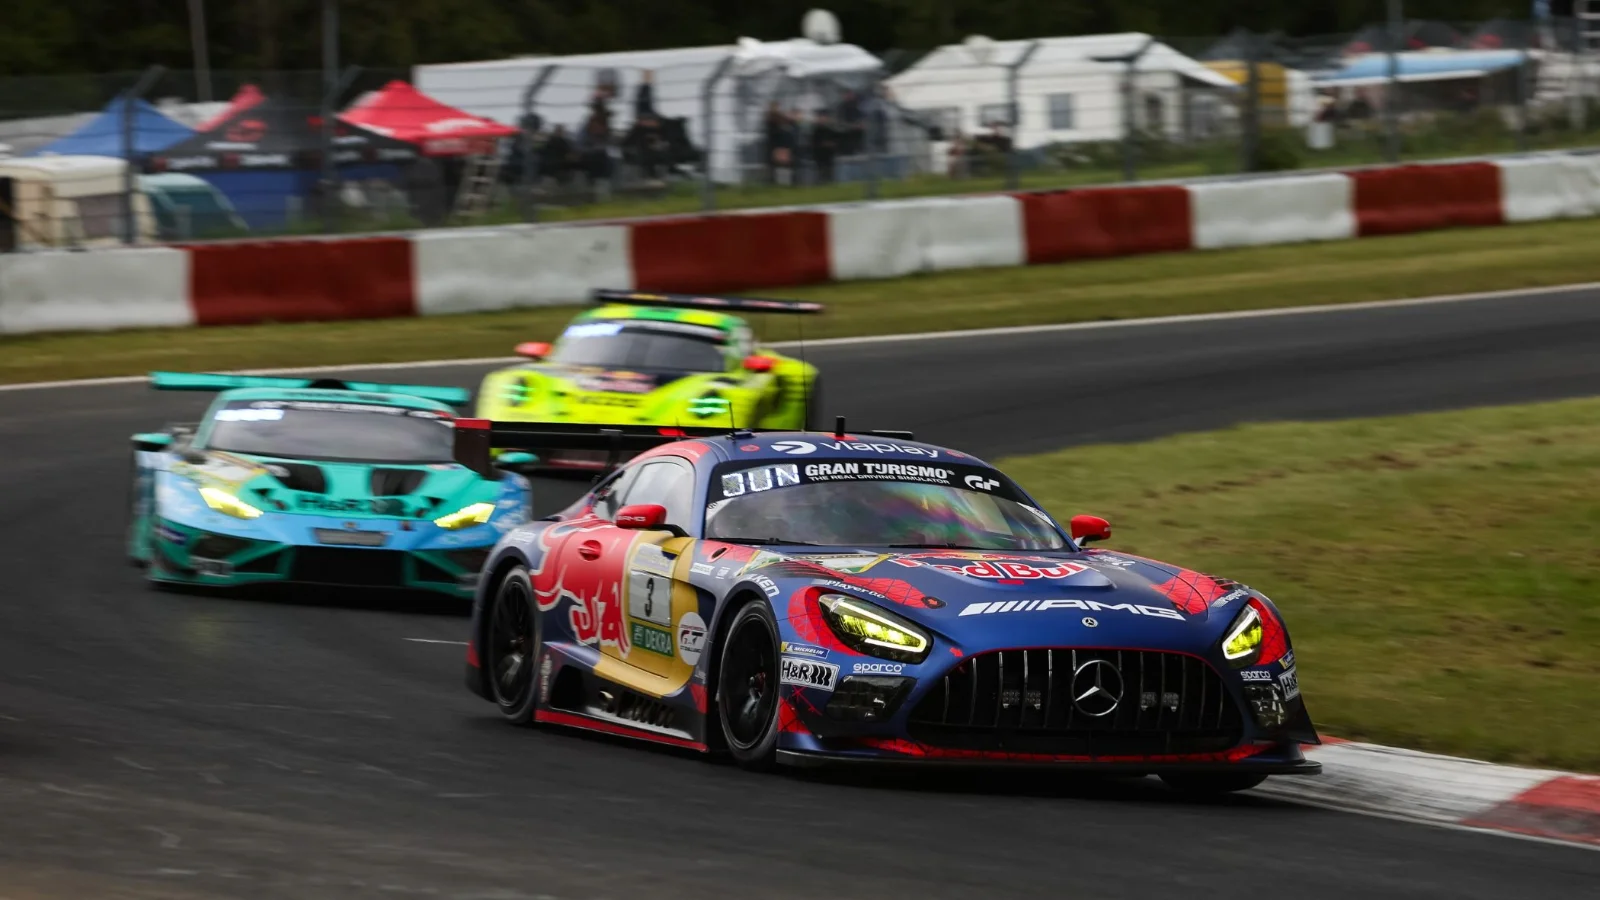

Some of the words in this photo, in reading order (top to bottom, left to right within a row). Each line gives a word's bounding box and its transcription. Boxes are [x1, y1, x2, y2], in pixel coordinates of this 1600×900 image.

[820, 441, 939, 459] viaplay
[804, 462, 860, 477] GRAN
[721, 463, 800, 497] JUN
[898, 475, 951, 486] SIMULATOR
[643, 577, 655, 617] 3
[1035, 599, 1187, 622] AMG
[644, 627, 674, 655] DEKRA
[793, 646, 825, 656] MICHELIN
[781, 659, 811, 682] H&R
[852, 662, 903, 674] sparco
[1240, 670, 1271, 680] sparco
